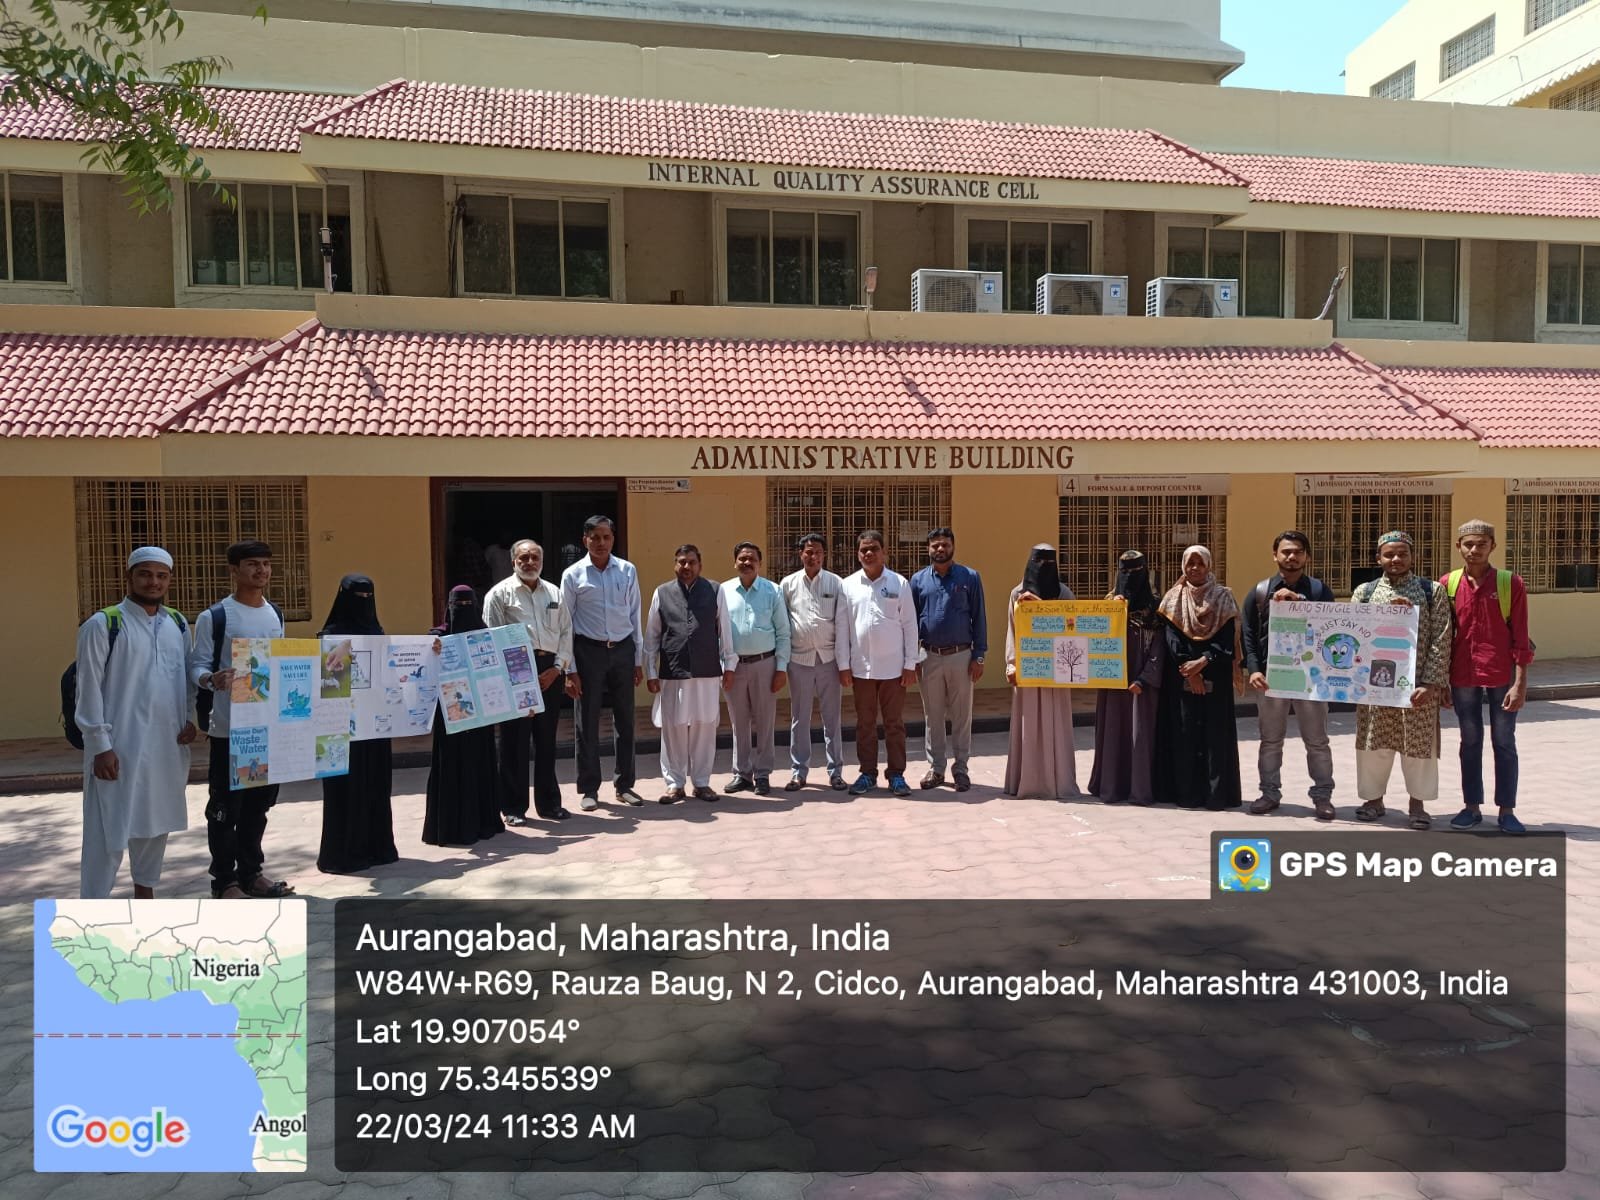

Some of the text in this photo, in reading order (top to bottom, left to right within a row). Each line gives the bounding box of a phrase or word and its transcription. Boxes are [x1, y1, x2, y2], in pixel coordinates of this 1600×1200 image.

[647, 162, 1040, 200] INTERNAL QUALITY ASSURANCE CELL
[690, 445, 1075, 470] ADMINISTRATIVE BUILDING
[1065, 479, 1076, 493] 4
[1302, 478, 1311, 492] 3
[1512, 478, 1520, 491] 2
[1315, 603, 1351, 614] SINGLE
[1354, 605, 1372, 615] USE
[1376, 606, 1413, 616] PLASTIC
[1340, 619, 1358, 630] SAY
[1358, 626, 1372, 639] NO
[231, 735, 261, 746] Waste
[239, 743, 268, 755] Water
